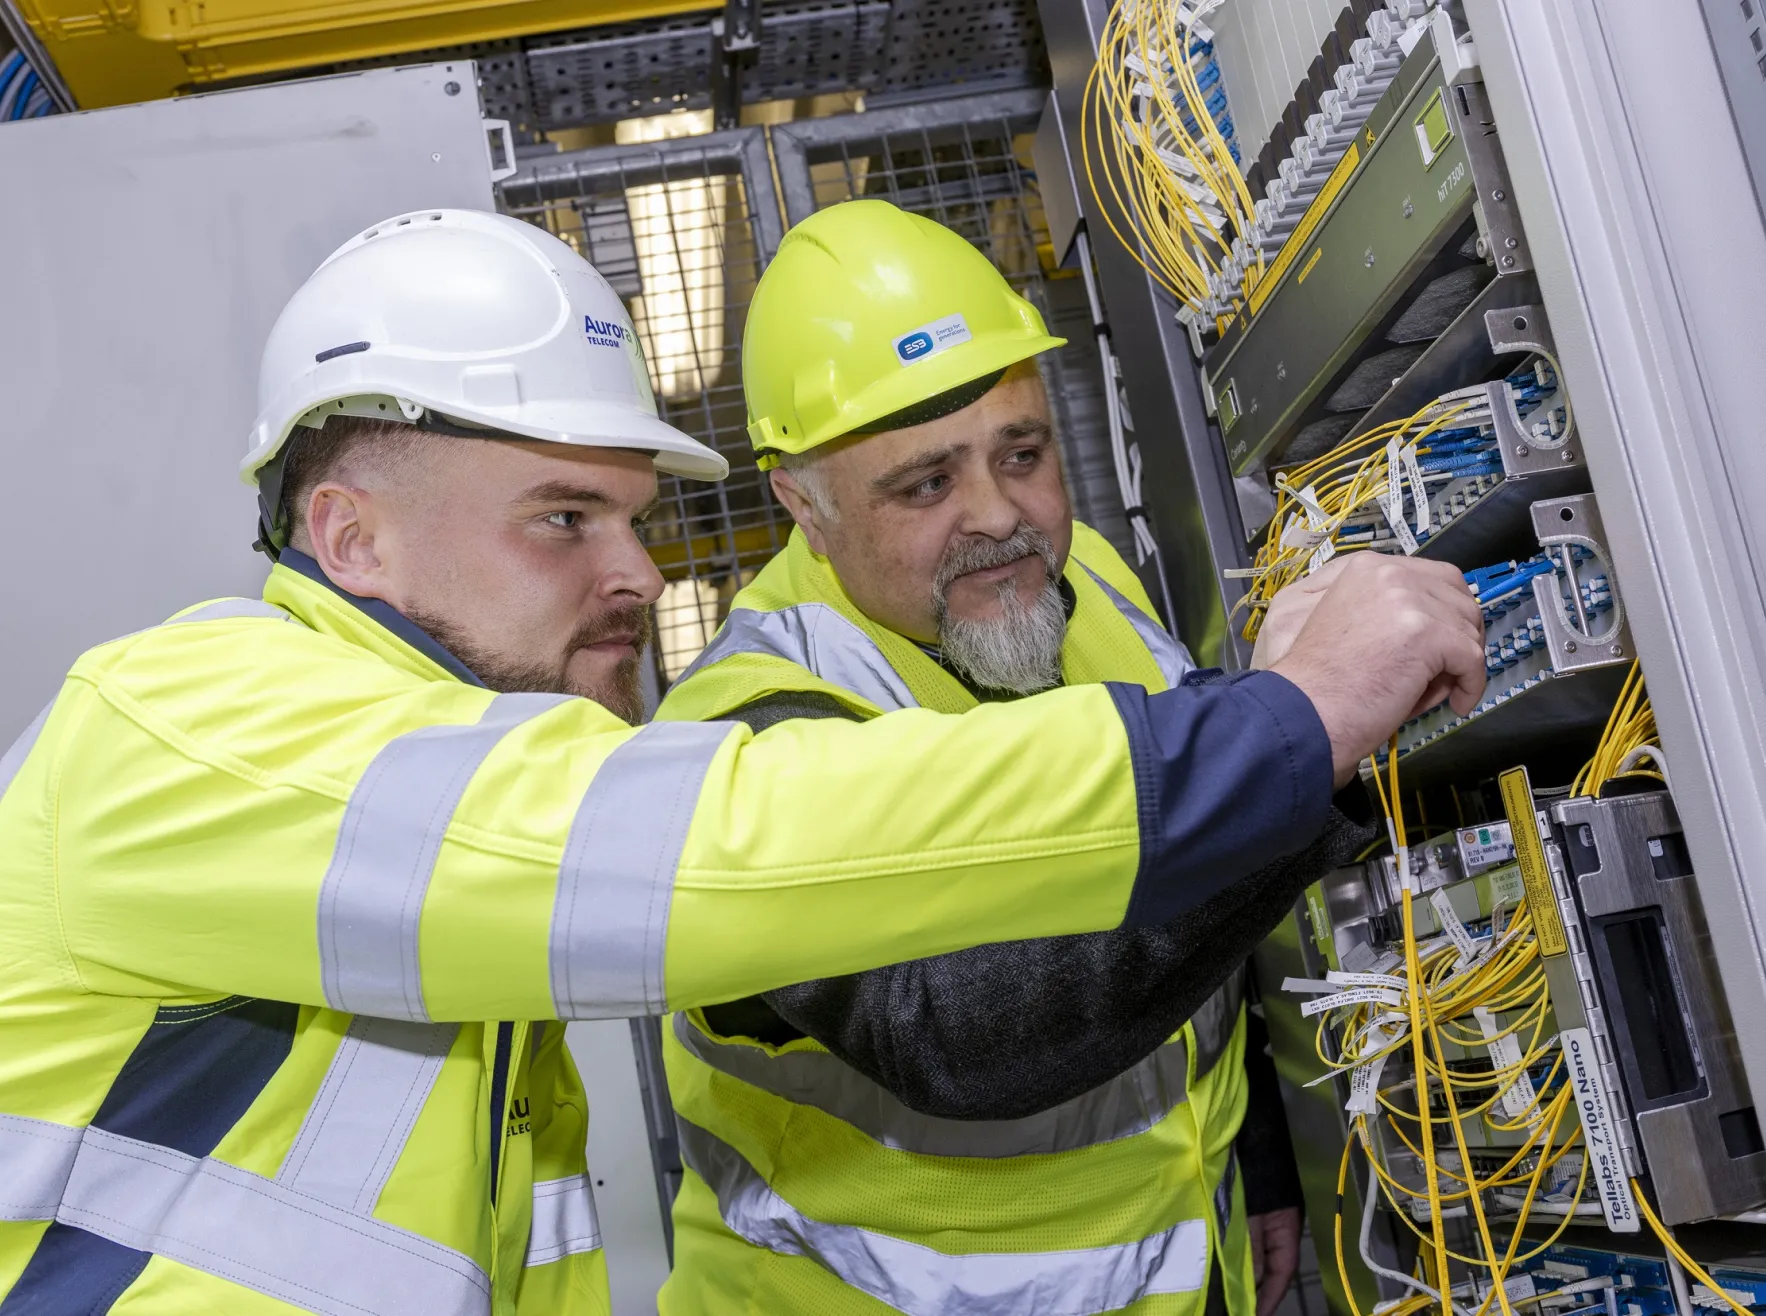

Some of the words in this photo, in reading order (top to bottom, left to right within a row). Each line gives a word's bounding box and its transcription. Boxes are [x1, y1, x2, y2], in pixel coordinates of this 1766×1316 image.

[1447, 162, 1465, 191] 7300
[585, 315, 633, 343] Aurora
[587, 336, 621, 348] TELECOM
[936, 326, 953, 336] Energy
[938, 328, 966, 342] generations
[904, 338, 927, 355] ESB
[1516, 826, 1527, 854] OPTICAL
[1470, 856, 1480, 864] REV
[1535, 904, 1543, 922] VIEW
[1571, 1039, 1591, 1094] Nano
[509, 1097, 530, 1120] u
[1591, 1078, 1605, 1120] System
[1583, 1100, 1604, 1147] 7100
[1601, 1121, 1619, 1177] Transport
[1599, 1155, 1622, 1225] Tellabs
[1616, 1180, 1631, 1221] Optical
